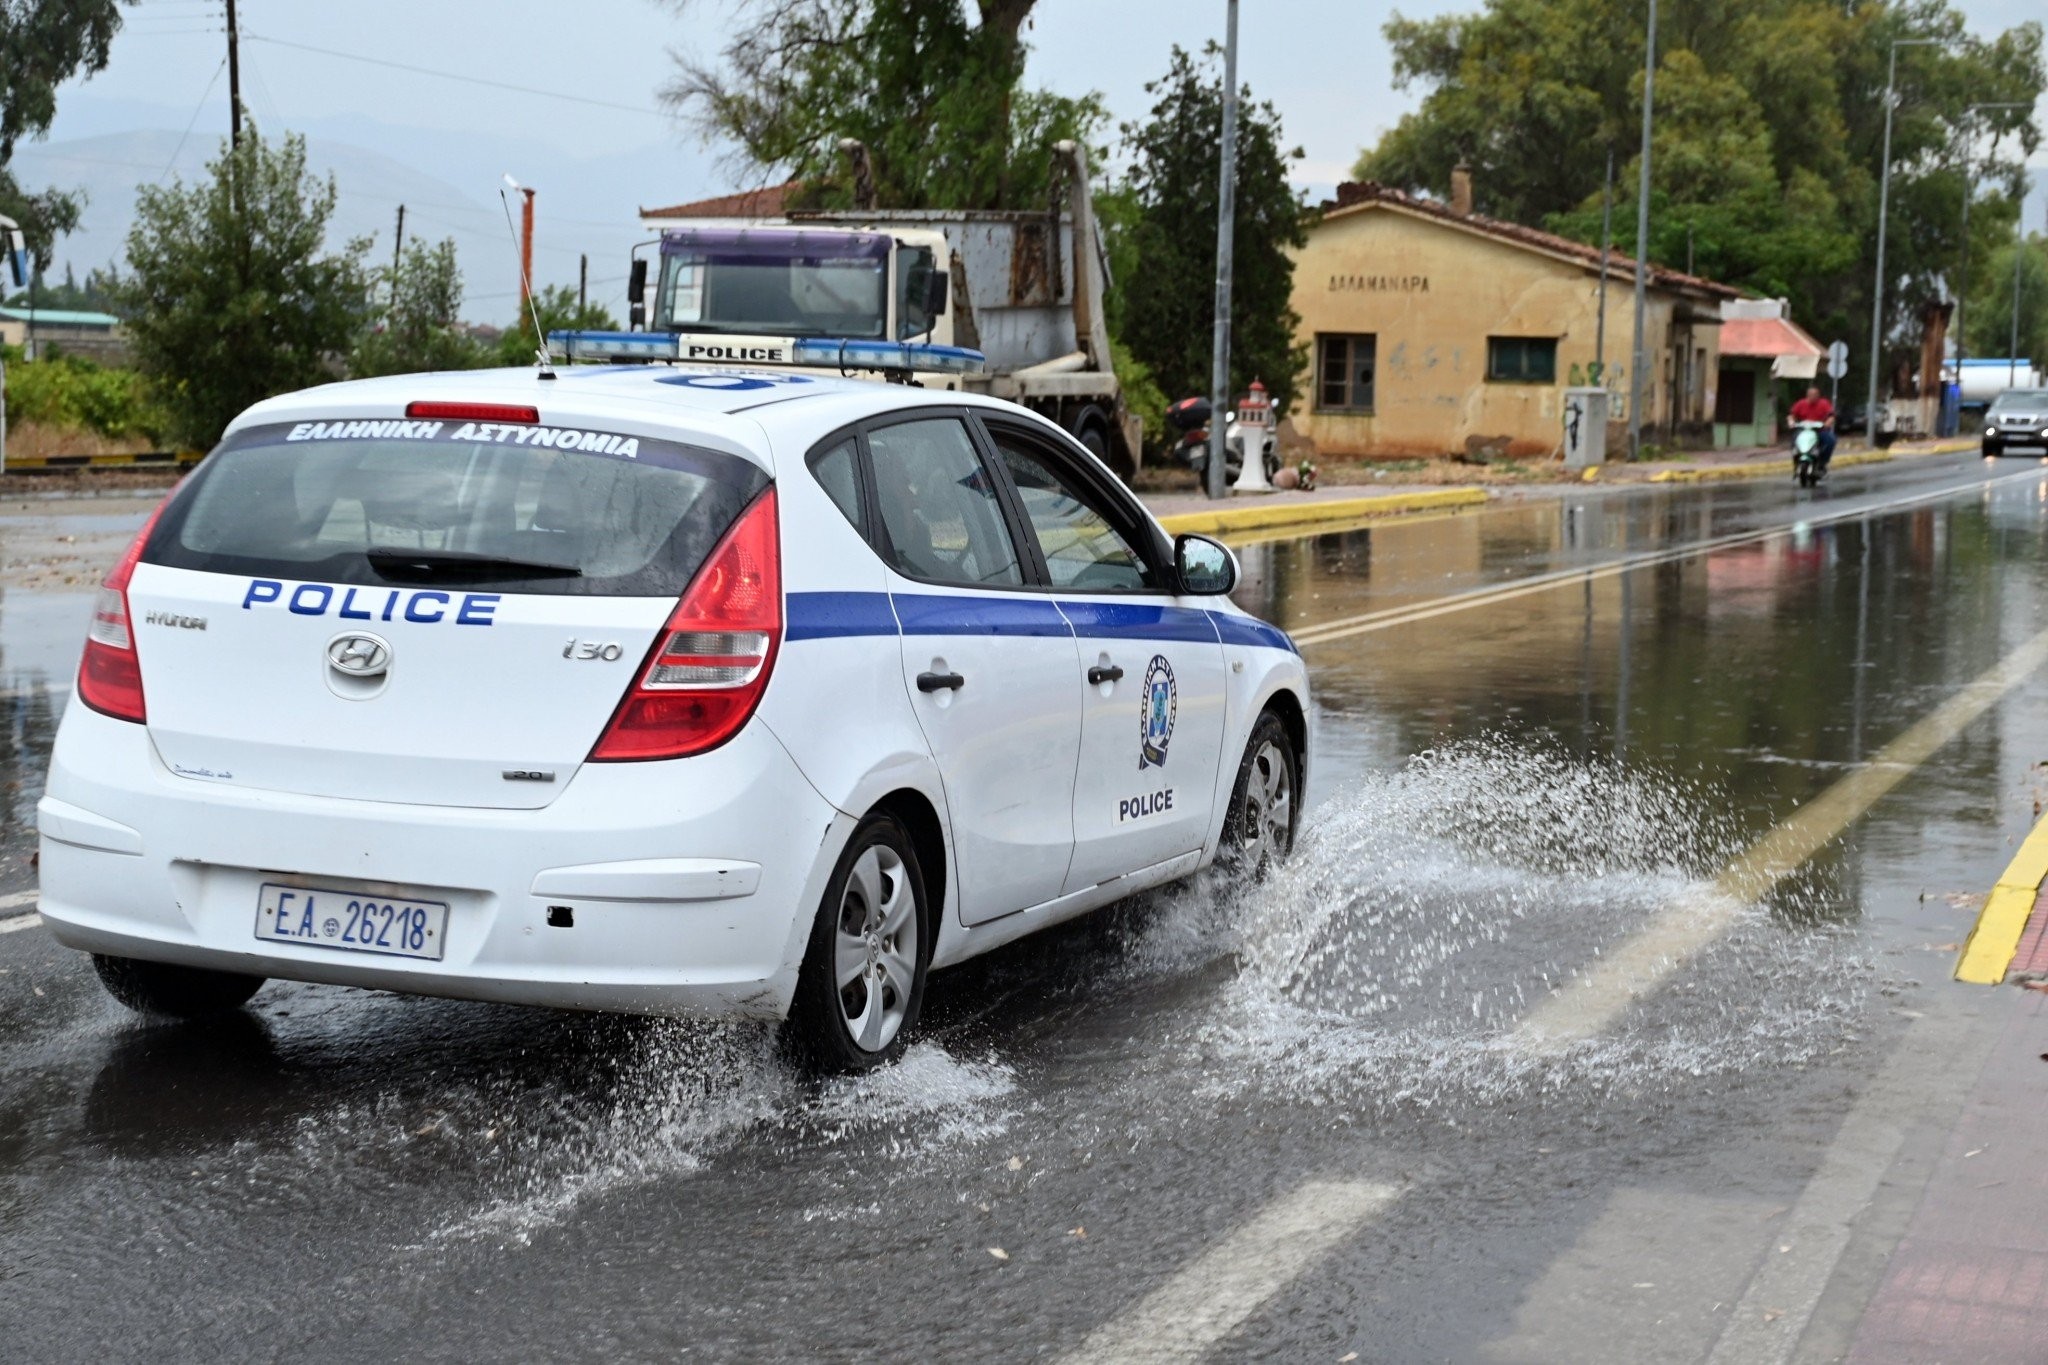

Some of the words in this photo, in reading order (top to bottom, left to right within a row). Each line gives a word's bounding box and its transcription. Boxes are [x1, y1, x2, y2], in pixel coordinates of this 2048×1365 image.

[688, 346, 783, 361] POLICE
[286, 421, 444, 441] ΕΛΛΗΝΙΚΗ
[450, 422, 640, 458] ΑΣΤΥΝΟΜΙΑ
[242, 580, 501, 626] POLICE
[145, 609, 208, 631] HYUNDAI
[562, 636, 623, 661] i30
[1119, 788, 1173, 821] POLICE
[342, 900, 427, 950] 26218
